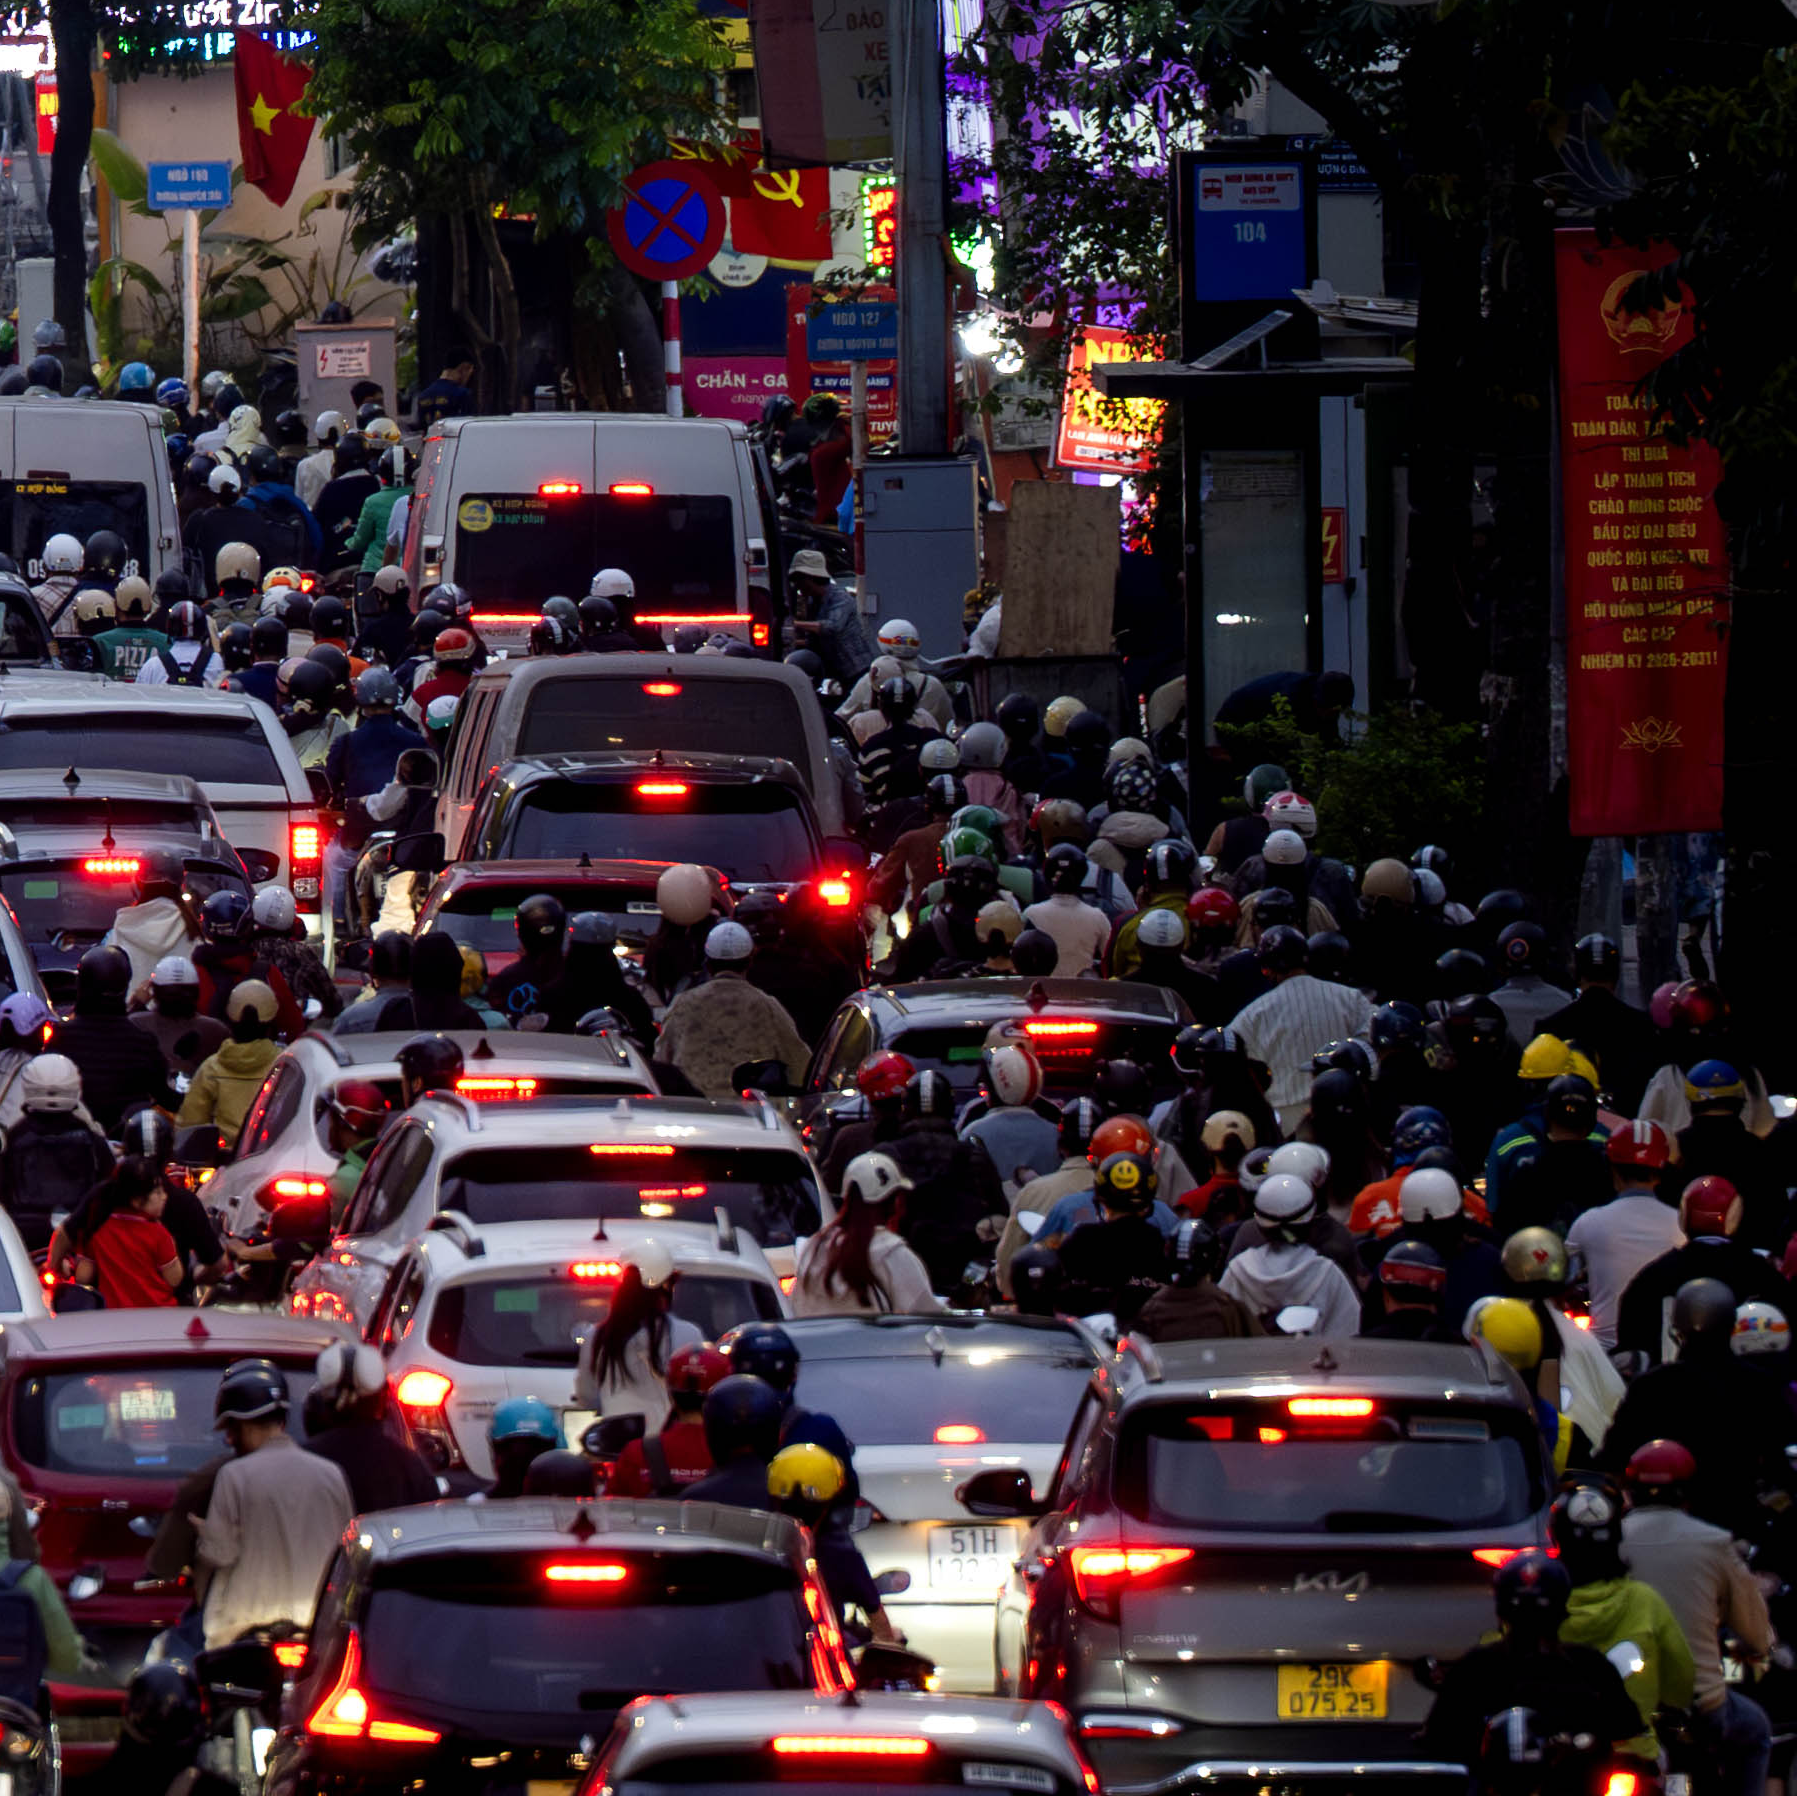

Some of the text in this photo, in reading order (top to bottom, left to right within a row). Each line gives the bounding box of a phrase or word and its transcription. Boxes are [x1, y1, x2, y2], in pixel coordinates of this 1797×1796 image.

[695, 370, 746, 389] CHĂN
[950, 1529, 998, 1556] 51H
[1288, 1691, 1377, 1716] 075.25
